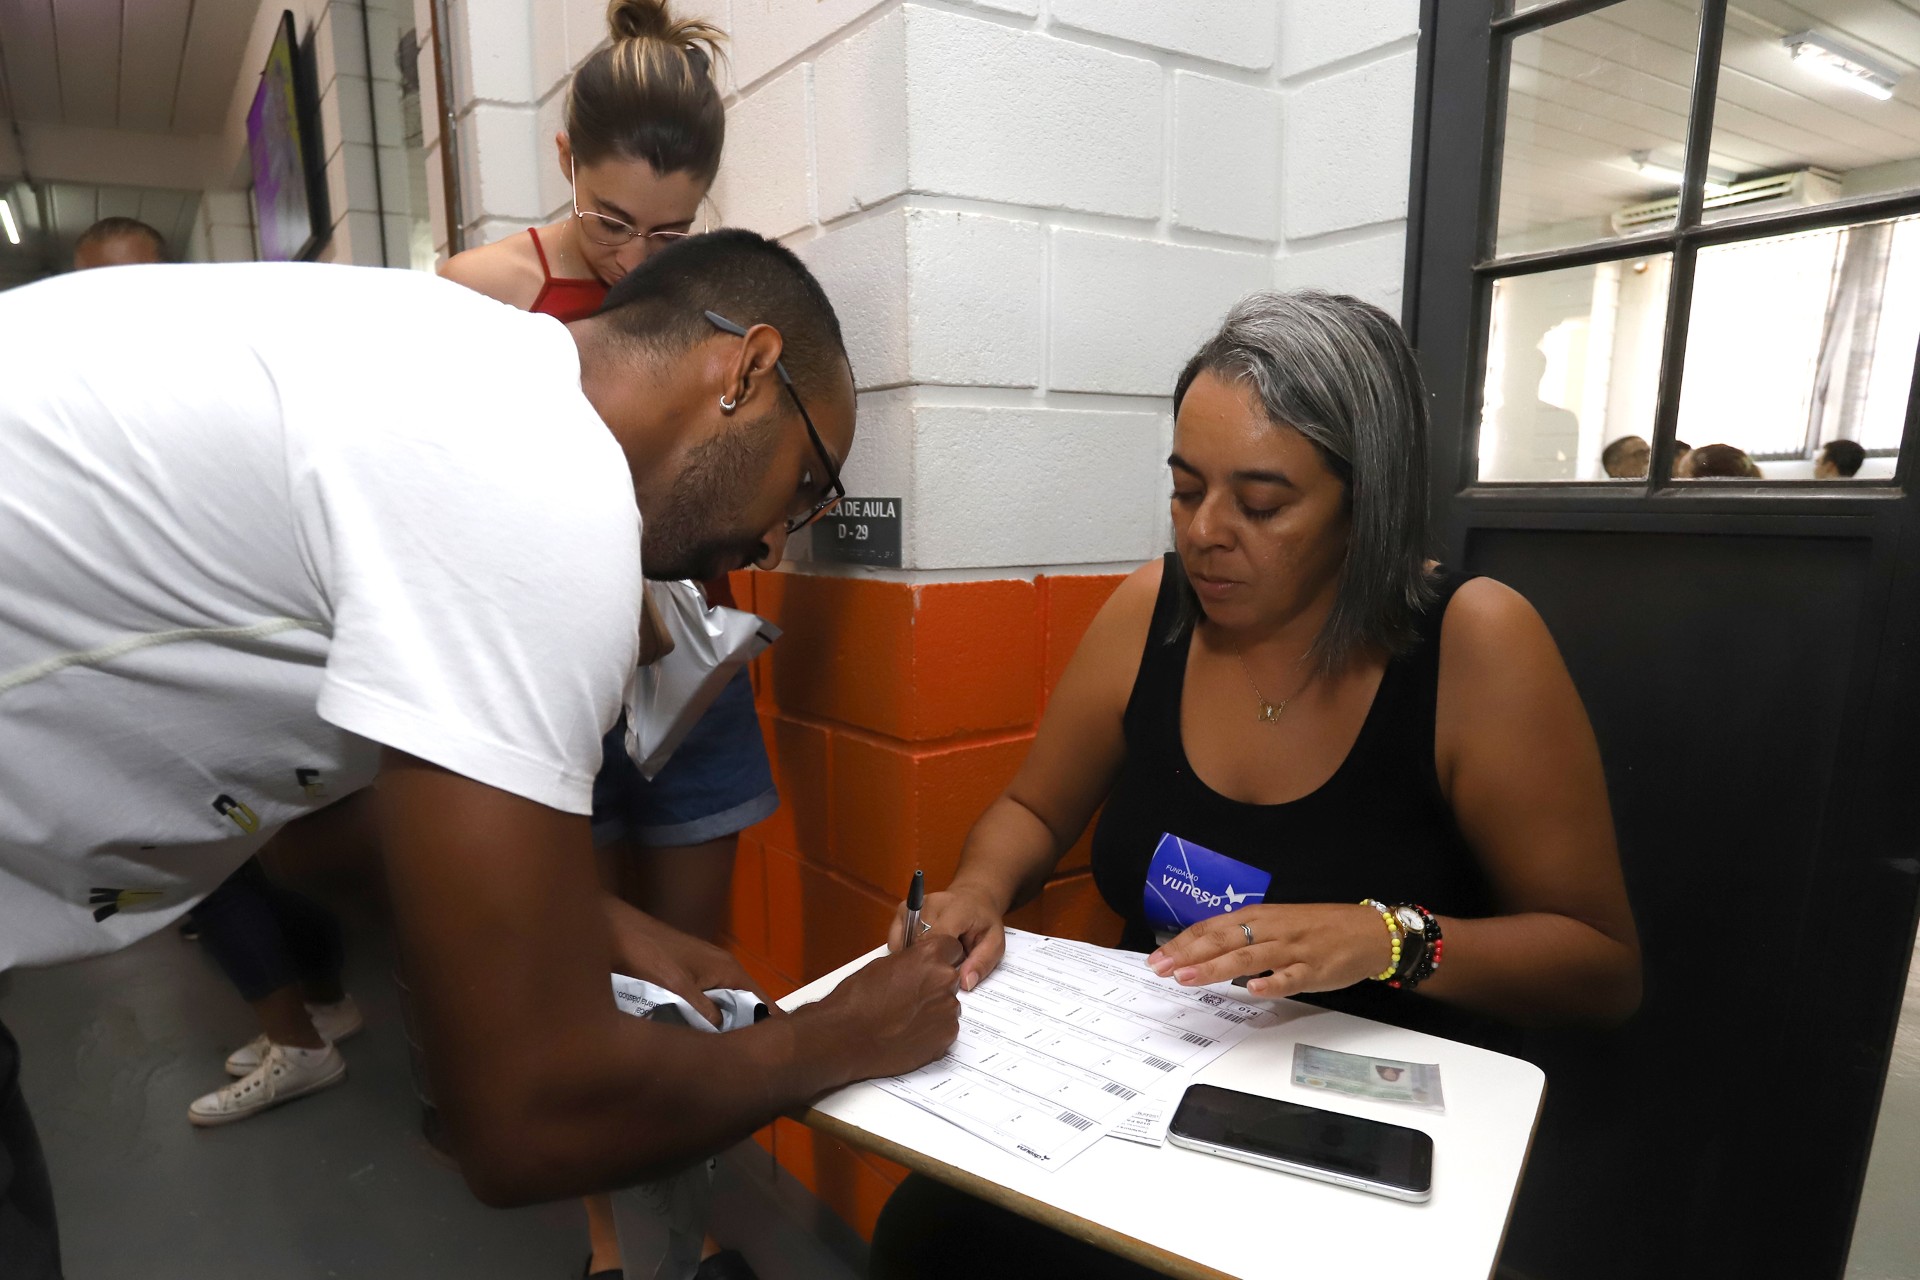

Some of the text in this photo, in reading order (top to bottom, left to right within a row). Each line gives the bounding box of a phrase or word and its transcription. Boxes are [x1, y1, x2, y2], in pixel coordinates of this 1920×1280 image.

[845, 501, 861, 517] DE
[862, 501, 896, 518] AULA
[838, 523, 847, 539] D
[855, 524, 869, 540] 29
[1165, 864, 1199, 882] FUNDAÇÃO
[1162, 873, 1221, 908] vunesp
[1238, 1006, 1258, 1016] 014
